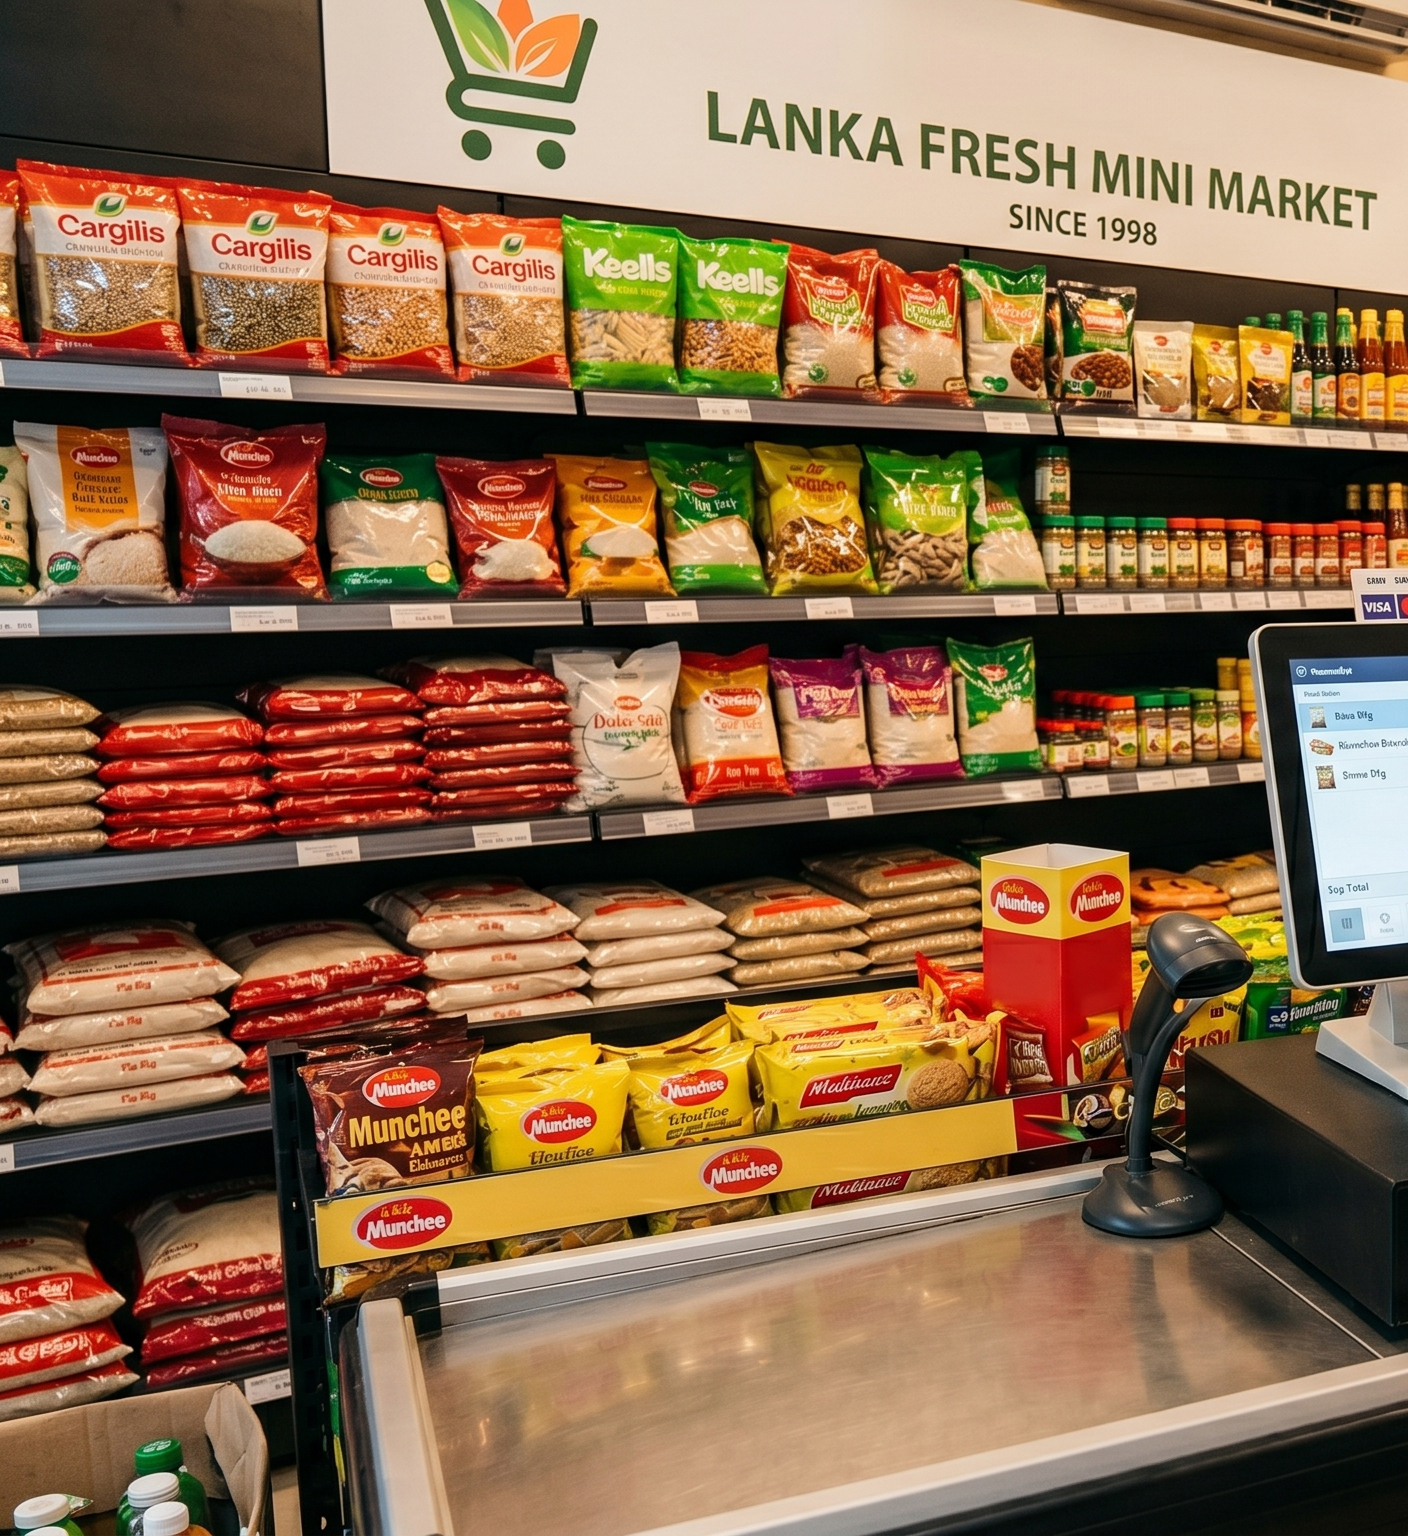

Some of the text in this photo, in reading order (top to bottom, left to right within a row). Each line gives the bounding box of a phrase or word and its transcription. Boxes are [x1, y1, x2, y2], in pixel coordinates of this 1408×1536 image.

[706, 90, 1378, 231] LANKA FRESH MINI MARKET
[57, 214, 166, 246] Cargilis
[1009, 203, 1157, 246] SINCE 1998
[211, 233, 312, 264] Cargilis
[347, 244, 439, 273] Cargilis
[472, 255, 556, 282] Cargilis
[583, 247, 672, 284] Keells
[697, 260, 779, 297] Keells
[1363, 601, 1392, 613] VISA
[996, 890, 1045, 915] Munchee
[1346, 882, 1369, 893] Total
[373, 1077, 436, 1101] Munchee
[664, 1078, 725, 1100] Munchee
[348, 1104, 467, 1148] Munchee
[529, 1113, 592, 1136] Munchee
[708, 1159, 780, 1191] Munchee
[364, 1211, 447, 1242] Munchee
